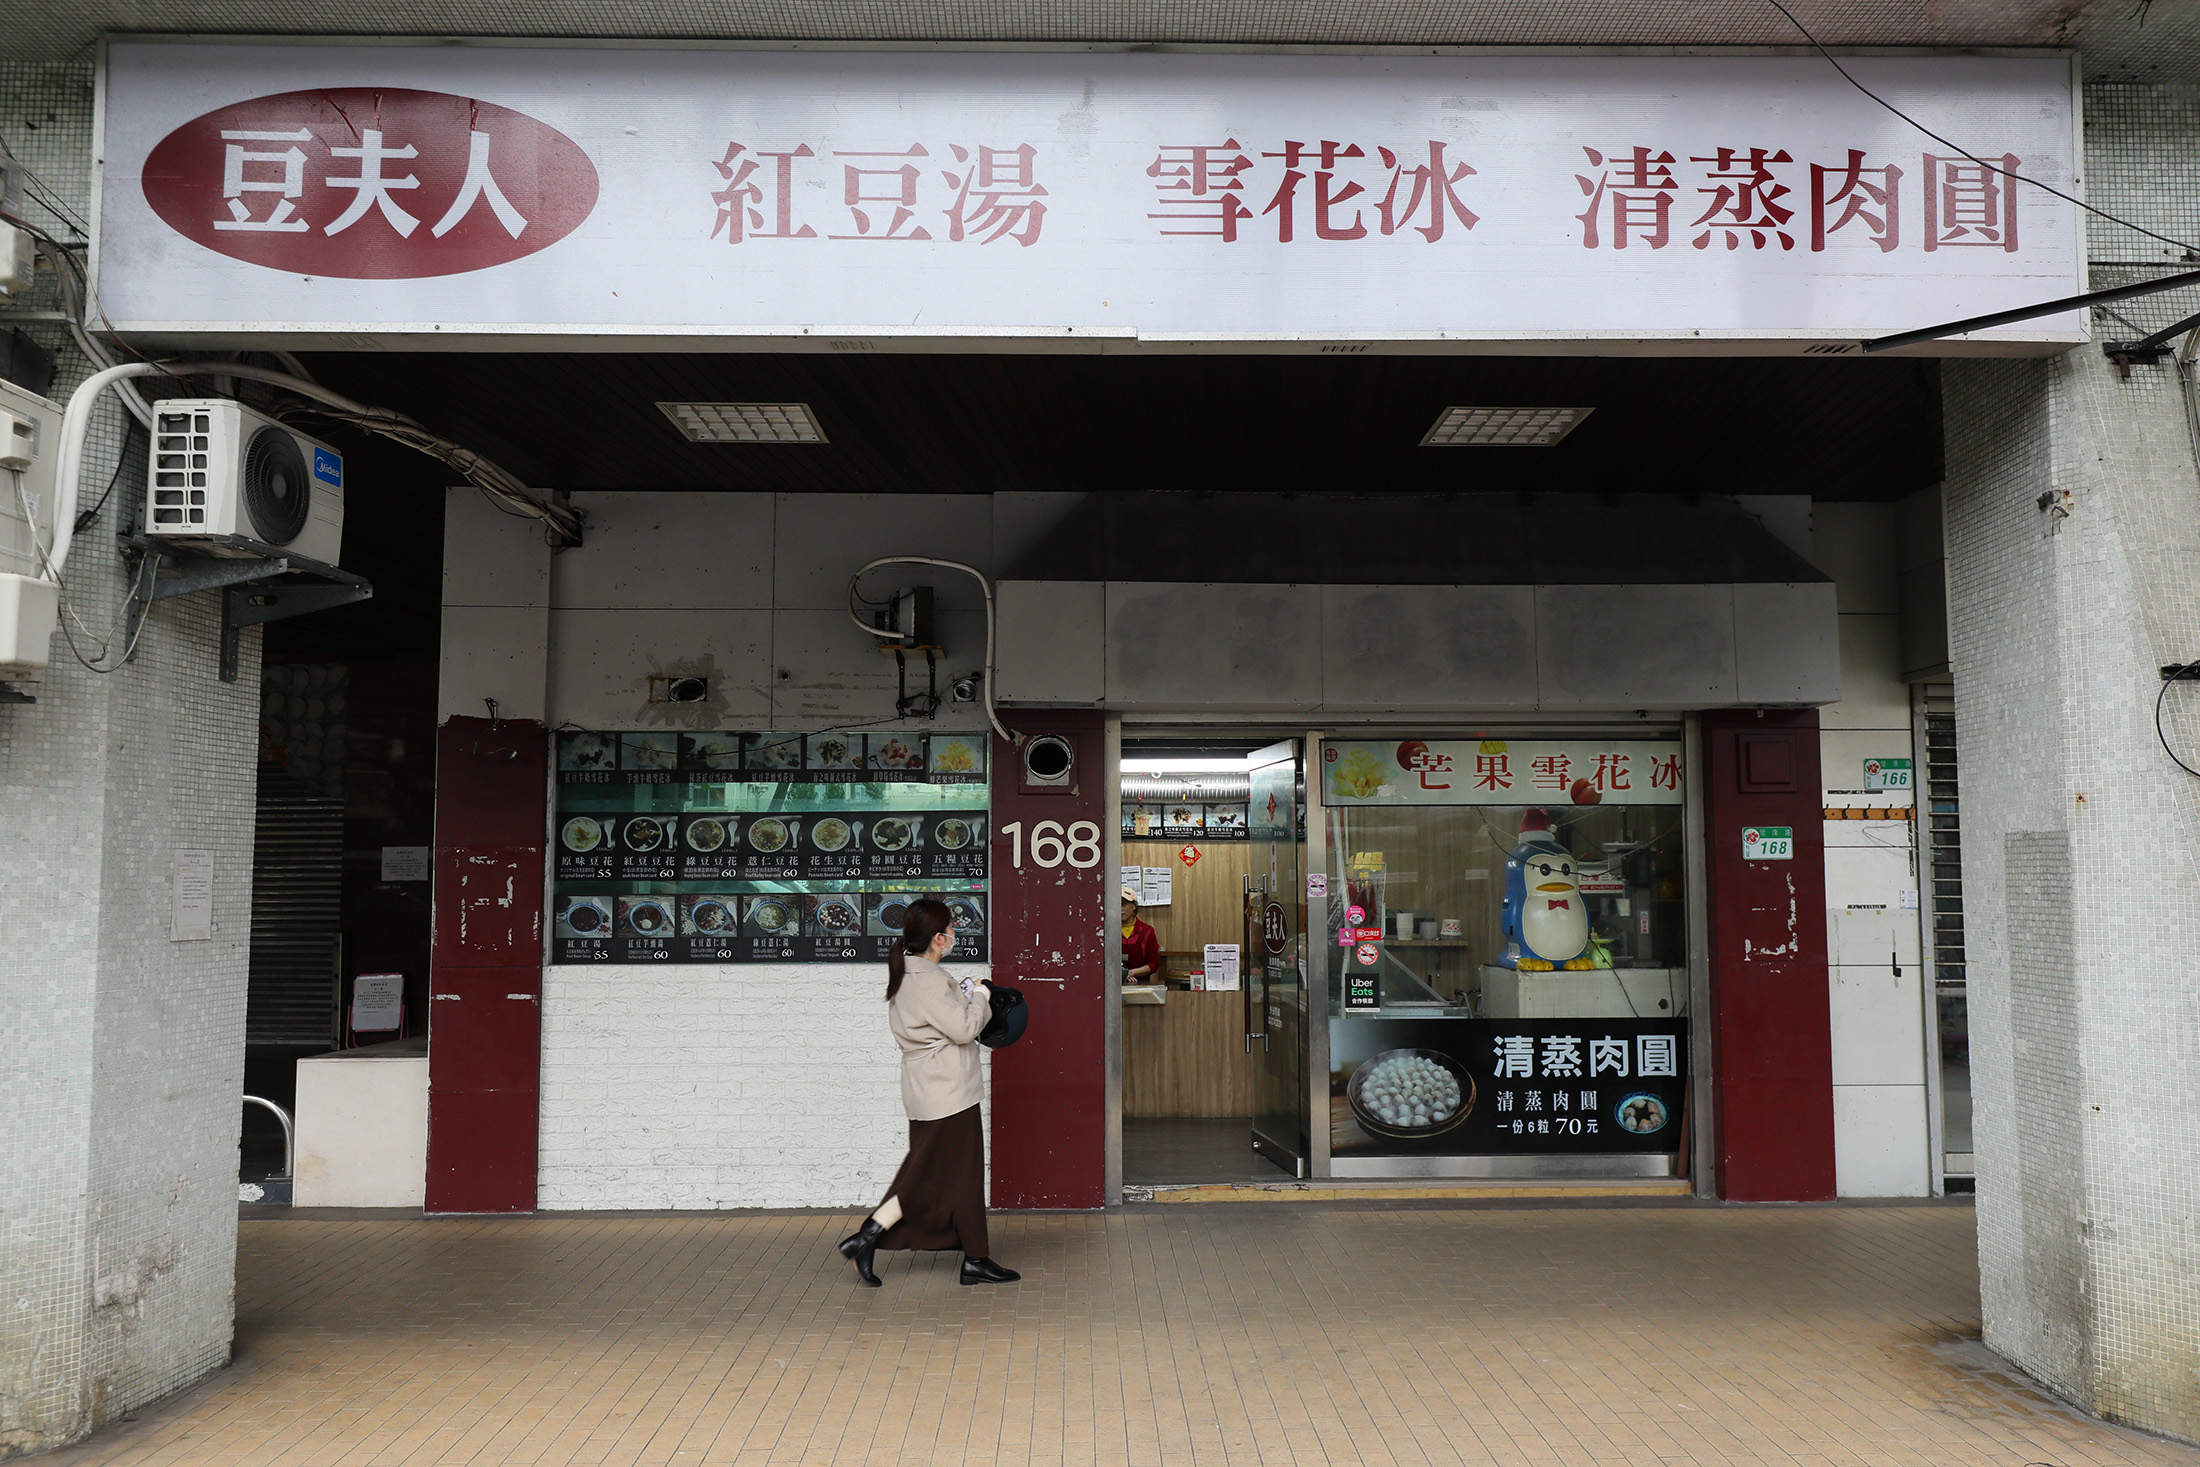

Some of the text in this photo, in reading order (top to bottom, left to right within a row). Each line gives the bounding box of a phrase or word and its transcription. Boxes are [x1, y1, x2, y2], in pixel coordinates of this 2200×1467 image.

[213, 127, 528, 239] 豆夫人
[710, 137, 2020, 254] 紅豆湯 雪花冰 清蒸肉圓
[316, 456, 340, 478] Midea
[1413, 753, 1682, 791] 芒果雪花冰
[1882, 772, 1907, 785] 166
[1001, 820, 1102, 869] 168
[1761, 841, 1787, 854] 168
[562, 856, 613, 866] 原味豆花
[624, 856, 675, 866] 紅豆豆花
[686, 856, 737, 866] 綠豆豆花
[748, 856, 798, 866] 薏仁豆花
[810, 855, 861, 865] 花生豆花
[871, 855, 922, 865] 粉圓豆花
[597, 868, 611, 878] 55
[659, 868, 674, 878] 60
[721, 868, 736, 878] 60
[783, 868, 798, 877] 60
[846, 867, 861, 876] 60
[906, 867, 921, 876] 60
[968, 868, 983, 877] 70
[1265, 911, 1285, 940] 豆夫人
[567, 939, 601, 948] 紅豆湯
[594, 950, 608, 960] 55
[654, 950, 668, 960] 60
[717, 949, 732, 958] 60
[781, 949, 792, 957] 60
[841, 948, 856, 957] 60
[963, 947, 978, 956] 70
[1351, 978, 1373, 987] Uber
[1351, 987, 1373, 996] Eats
[1493, 1034, 1677, 1078] 清蒸肉圓
[1497, 1090, 1598, 1112] 清蒸肉圓
[1497, 1117, 1599, 1136] 一份6粒 70 元
